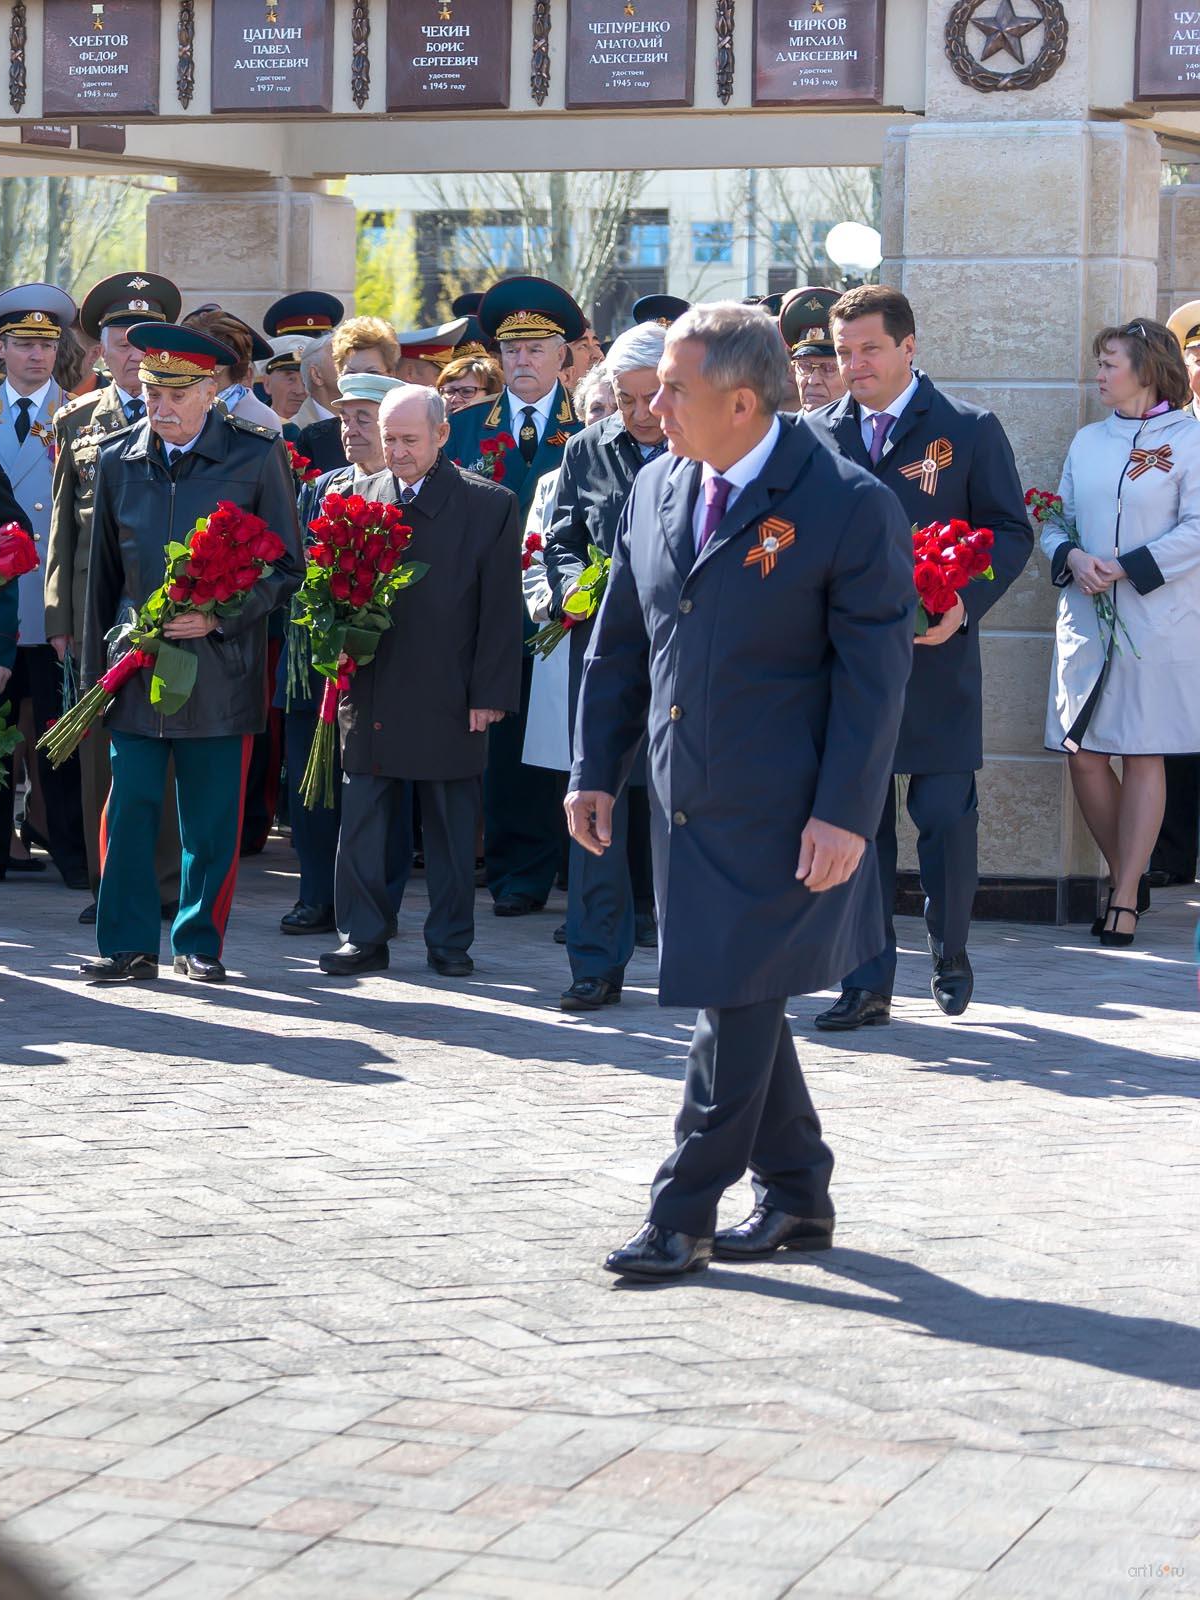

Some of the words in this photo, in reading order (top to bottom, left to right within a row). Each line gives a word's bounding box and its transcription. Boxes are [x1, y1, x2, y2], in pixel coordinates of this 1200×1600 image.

[588, 21, 670, 34] ЧЕПУРЕНКО
[788, 18, 848, 30] ЧИРКОВ
[243, 28, 302, 42] ЦАПЛИН
[422, 26, 470, 37] ЧЕКИН
[1173, 30, 1200, 40] АЛЕ
[68, 34, 129, 46] ХРЕБТОВ
[594, 34, 663, 48] АНАТОЛИЙ
[789, 36, 845, 46] МИХАИЛ
[253, 44, 290, 54] ПАВЕЛ
[426, 42, 464, 52] БОРИС
[79, 52, 118, 62] ФЕДОР
[412, 56, 478, 66] СЕРГЕЕВИЧ
[589, 52, 668, 64] АЛЕКСЕЕВИЧ
[776, 50, 858, 62] АЛЕКСЕЕВИЧ
[234, 58, 308, 68] АЛЕКСЕЕВИЧ
[68, 64, 129, 76] ЕФИМОВИЧ
[613, 80, 632, 88] 1945
[800, 78, 820, 86] 1943
[258, 84, 274, 92] 1937
